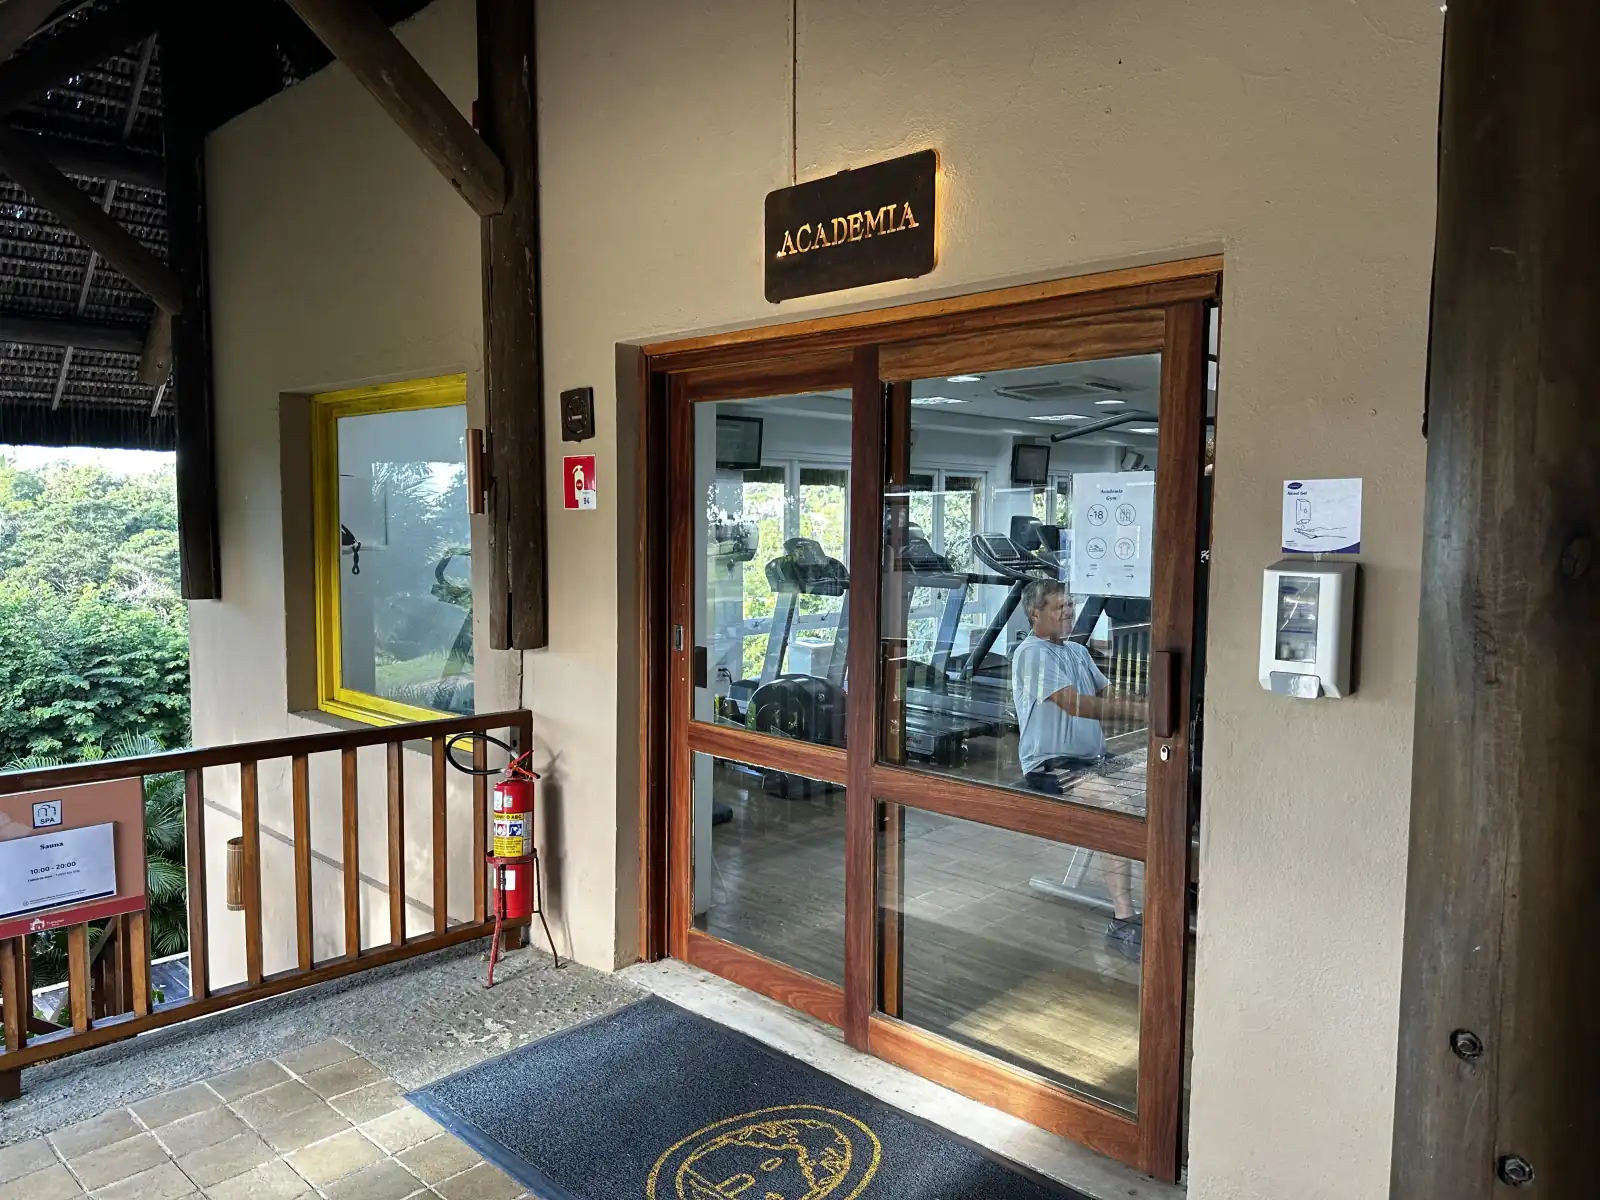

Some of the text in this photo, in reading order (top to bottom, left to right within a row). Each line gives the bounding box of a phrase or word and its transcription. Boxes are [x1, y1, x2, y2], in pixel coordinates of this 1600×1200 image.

[776, 201, 920, 257] ACADEMIA
[40, 817, 56, 825] SPA
[39, 841, 64, 850] Sauna
[30, 866, 50, 875] 10:00
[55, 861, 77, 870] 20:00
